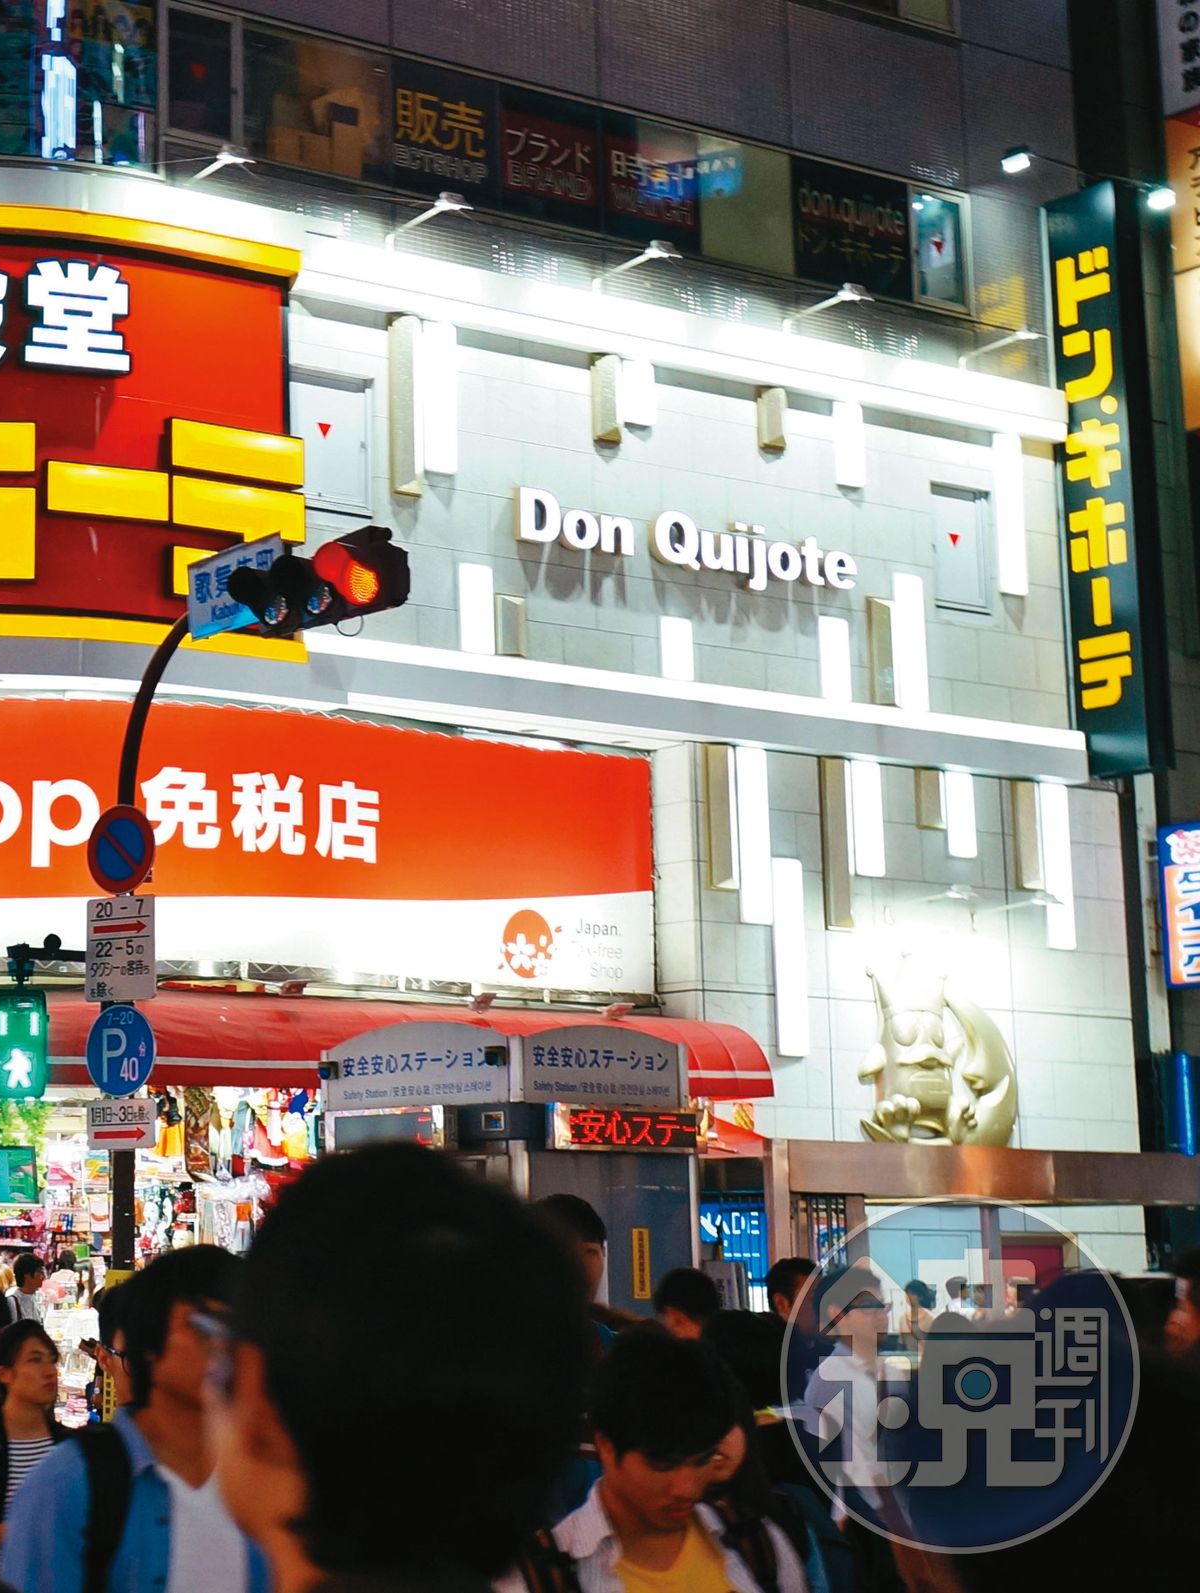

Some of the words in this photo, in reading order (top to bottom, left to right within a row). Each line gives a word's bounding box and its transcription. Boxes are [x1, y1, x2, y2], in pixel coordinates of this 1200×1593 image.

[395, 88, 487, 158] 販売
[506, 127, 591, 172] ブランド
[507, 159, 591, 200] BRAND
[514, 486, 634, 556] Don
[649, 510, 857, 591] Quijote
[140, 766, 380, 864] 免税店
[90, 983, 115, 998] を除く
[102, 1028, 127, 1083] P
[120, 1057, 139, 1082] 40
[533, 1045, 669, 1072] 安全安心ステーション
[365, 1088, 388, 1099] Station
